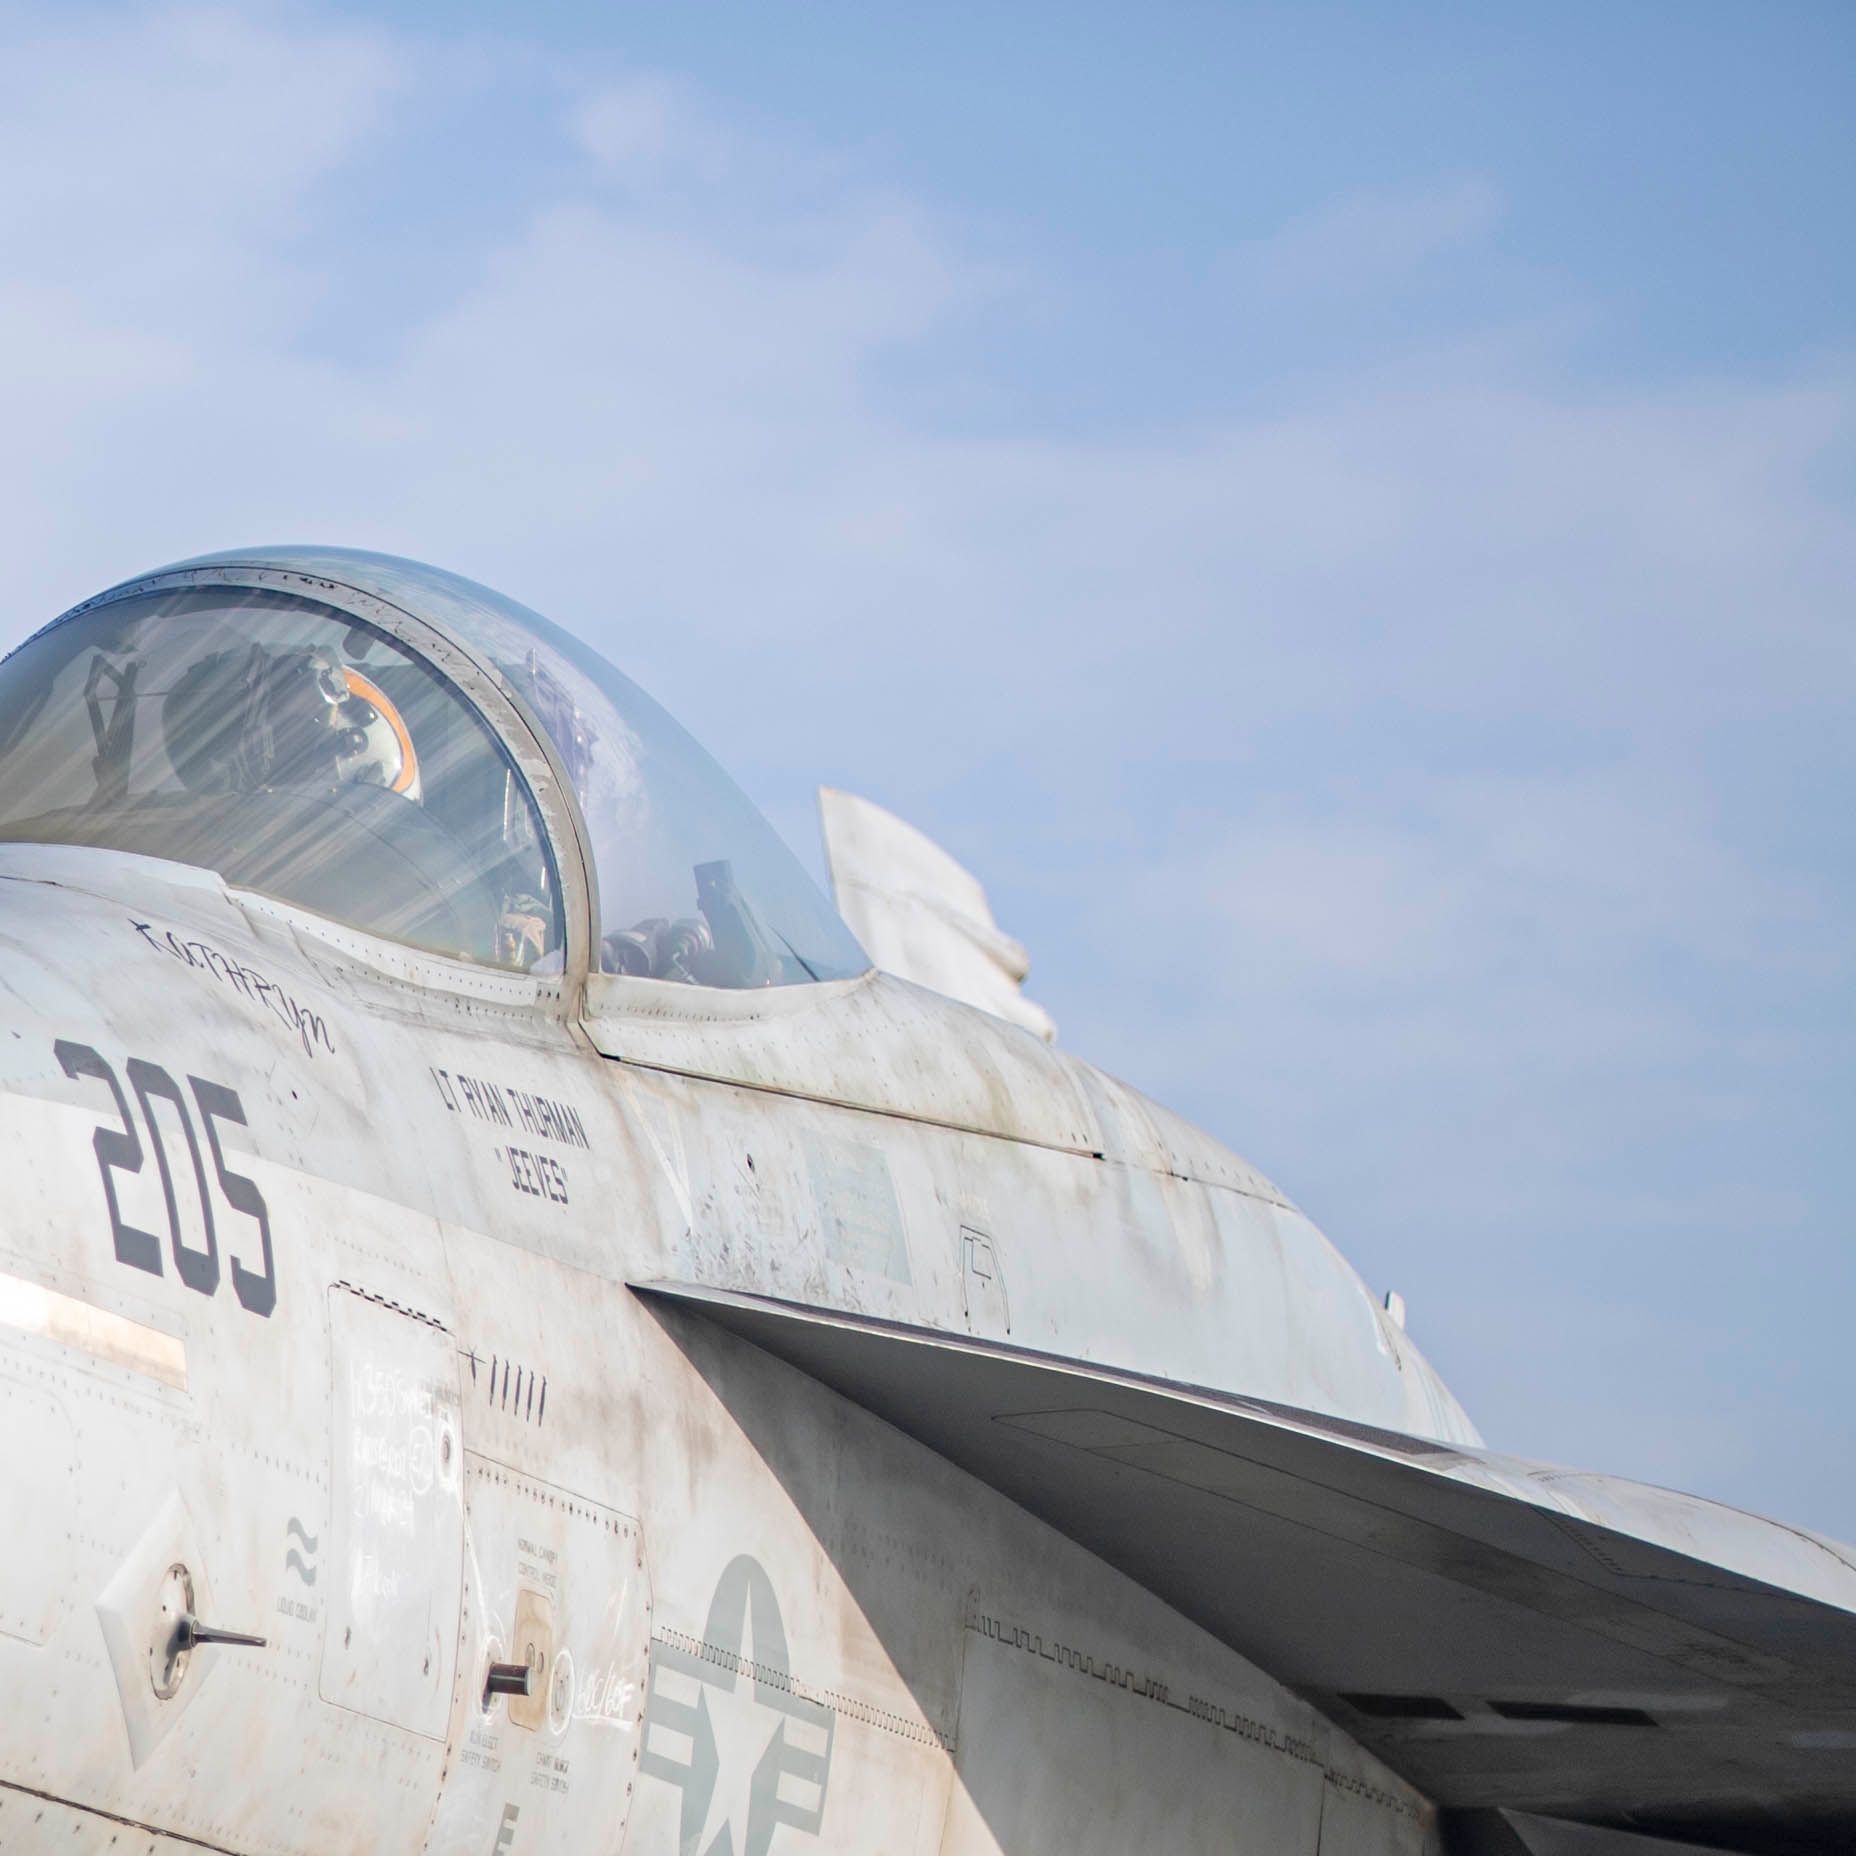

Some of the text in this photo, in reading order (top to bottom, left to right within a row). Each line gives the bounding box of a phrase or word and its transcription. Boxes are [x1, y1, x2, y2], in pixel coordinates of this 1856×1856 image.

[54, 1039, 277, 1317] 205
[430, 1067, 589, 1149] LT RYAN THURMAN
